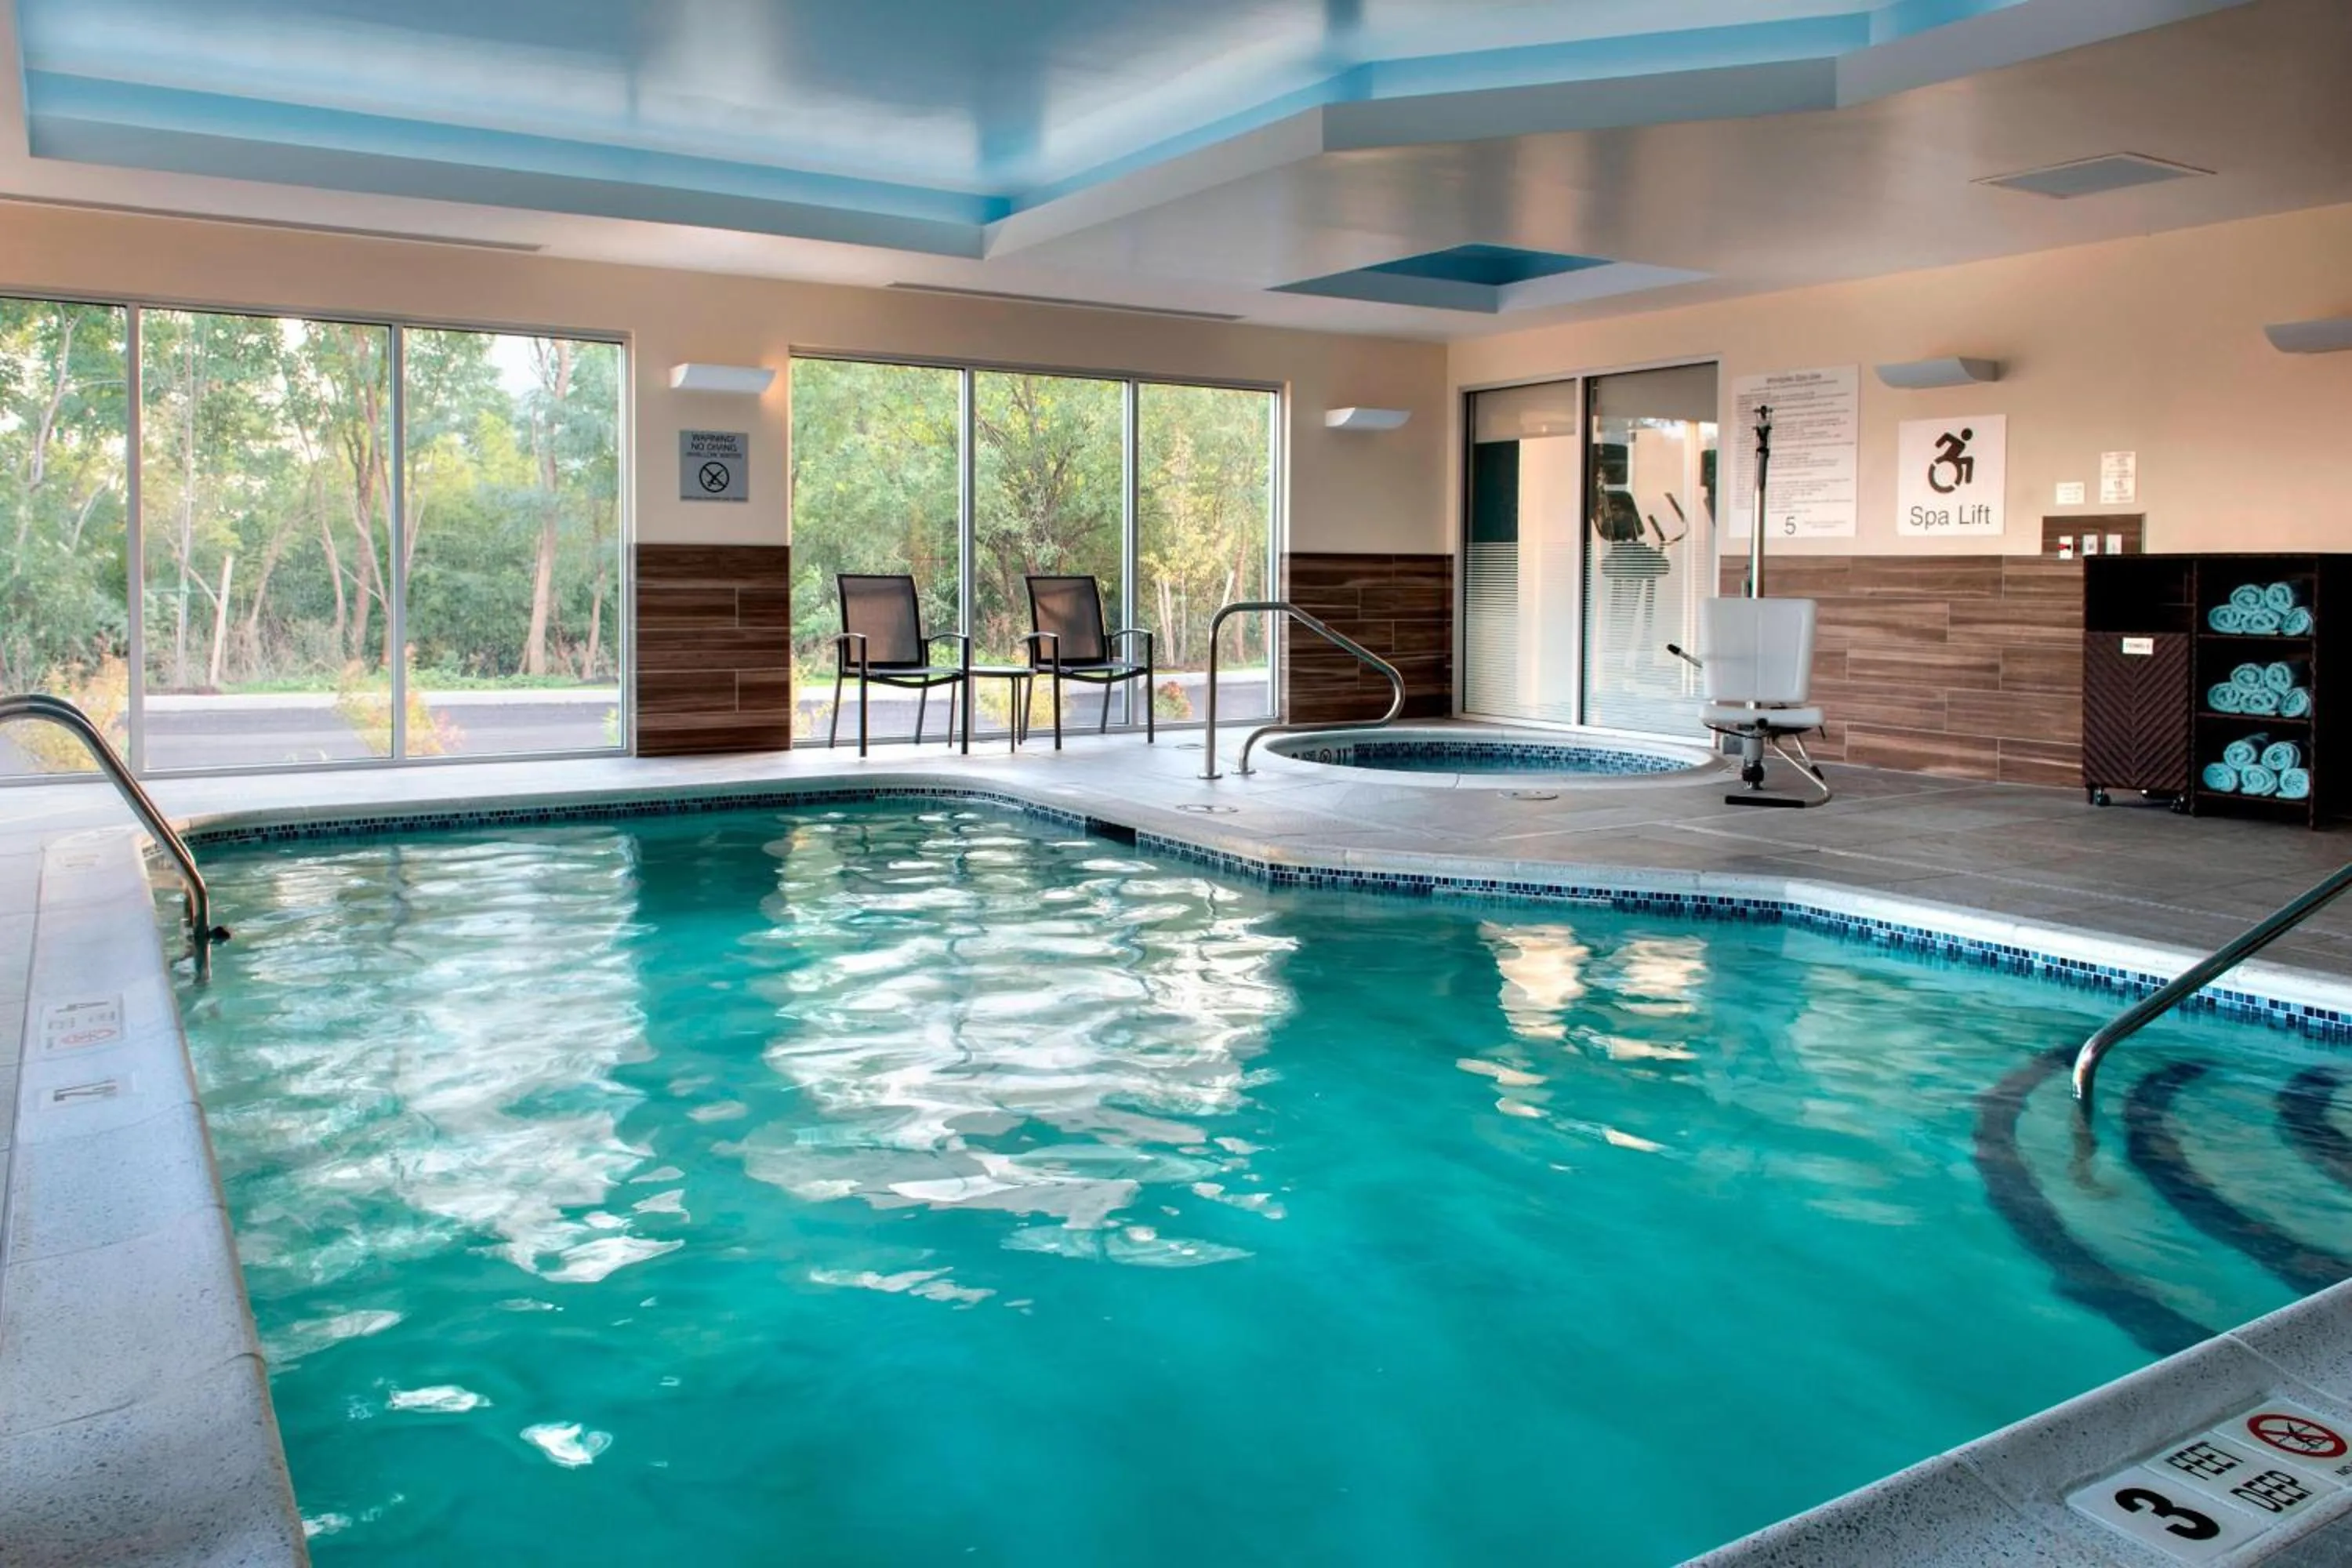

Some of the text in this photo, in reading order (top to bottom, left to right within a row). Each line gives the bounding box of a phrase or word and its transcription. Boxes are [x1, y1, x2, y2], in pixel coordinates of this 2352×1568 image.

[1784, 516, 1796, 535] 5
[1910, 504, 1991, 531] Spa Lift
[2164, 1441, 2245, 1480] FEET
[2230, 1470, 2314, 1513] DEEP
[2114, 1488, 2221, 1541] 3
